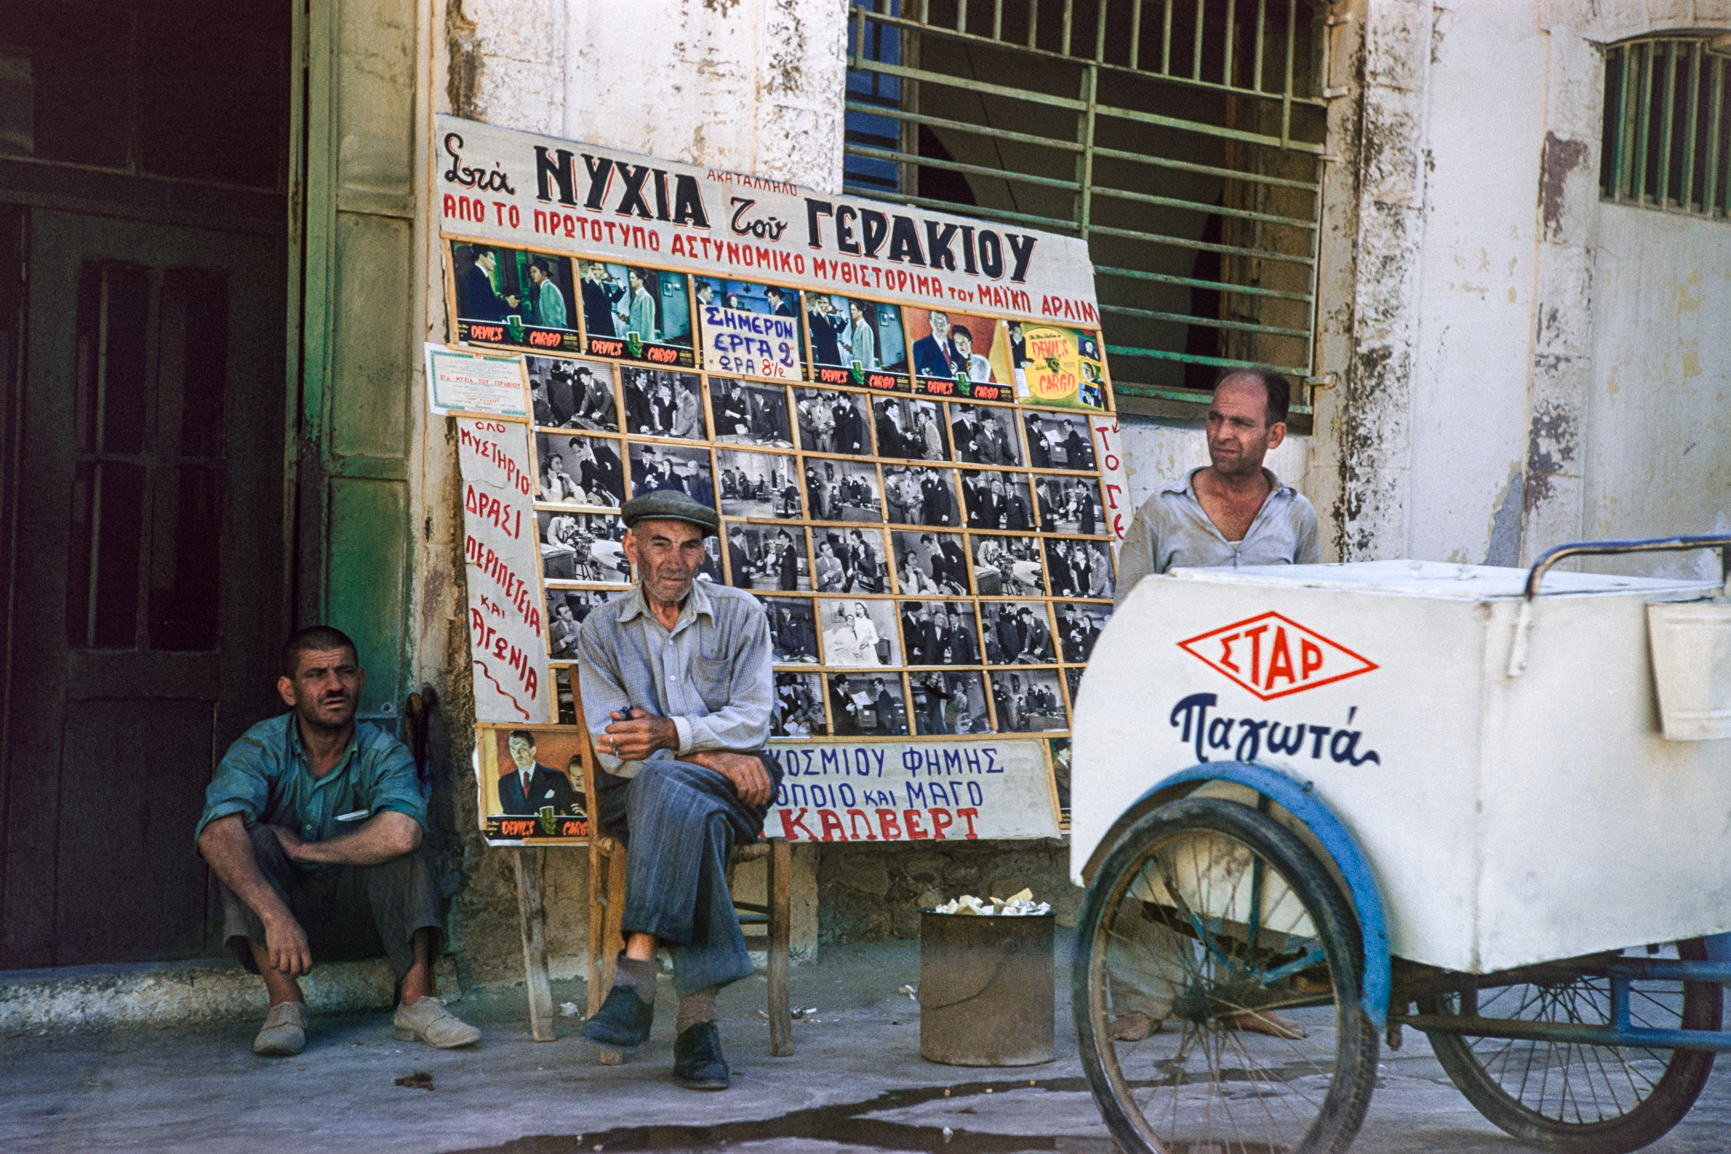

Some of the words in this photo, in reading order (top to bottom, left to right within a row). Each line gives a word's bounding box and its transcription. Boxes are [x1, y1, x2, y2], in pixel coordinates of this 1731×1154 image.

[533, 145, 711, 230] ΝΥΧΙΑ
[804, 197, 1038, 284] ΓΕΡΑΚΙΟΥ
[443, 193, 485, 223] ΑΠΟ
[492, 201, 521, 229] ΤΟ
[533, 208, 660, 252] ΠΡΩΤΟΤΥΠΟ
[670, 233, 805, 275] ΑΣΤΥΝΟΜΙΚΟ
[813, 258, 944, 299] ΜΥΘΙΣΤΟΡΙΜΑ
[470, 324, 504, 342] DEVIL'S
[529, 330, 562, 347] CARGO
[705, 306, 794, 340] ΣΗΜΕΡΟΝ
[591, 339, 623, 356] DEVIL'S
[647, 346, 678, 363] CARGO
[713, 333, 774, 361] ΕΡΓΑ
[1031, 338, 1069, 359] DEVIL'S
[719, 355, 755, 375] ΩΡΑ
[869, 374, 895, 390] CARGO
[974, 385, 999, 399] CARGO
[1039, 372, 1076, 394] CARGO
[475, 421, 506, 433] ΟΛΟ
[460, 427, 530, 495] ΜΥΣΤΗΡΙΟ
[465, 484, 521, 540] ΔΡΑΣΙ
[1106, 483, 1125, 541] ΓΕ
[465, 535, 541, 638] ΠΕΡΙΠΕΤΕΙΑ
[480, 594, 505, 619] ΚΑΙ
[470, 607, 538, 701] ΑΓΩΝΙΑ
[1219, 624, 1324, 691] ΣΤΑΡ
[1170, 692, 1381, 767] Παγωτά
[902, 747, 1004, 778] ΦΗΜΗΣ
[775, 782, 856, 808] ΟΠΟΙΟ
[864, 789, 897, 807] ΚΑΙ
[906, 780, 984, 809] ΜΑΓΟ
[501, 820, 535, 836] DEVIL'S
[563, 821, 588, 836] CARG
